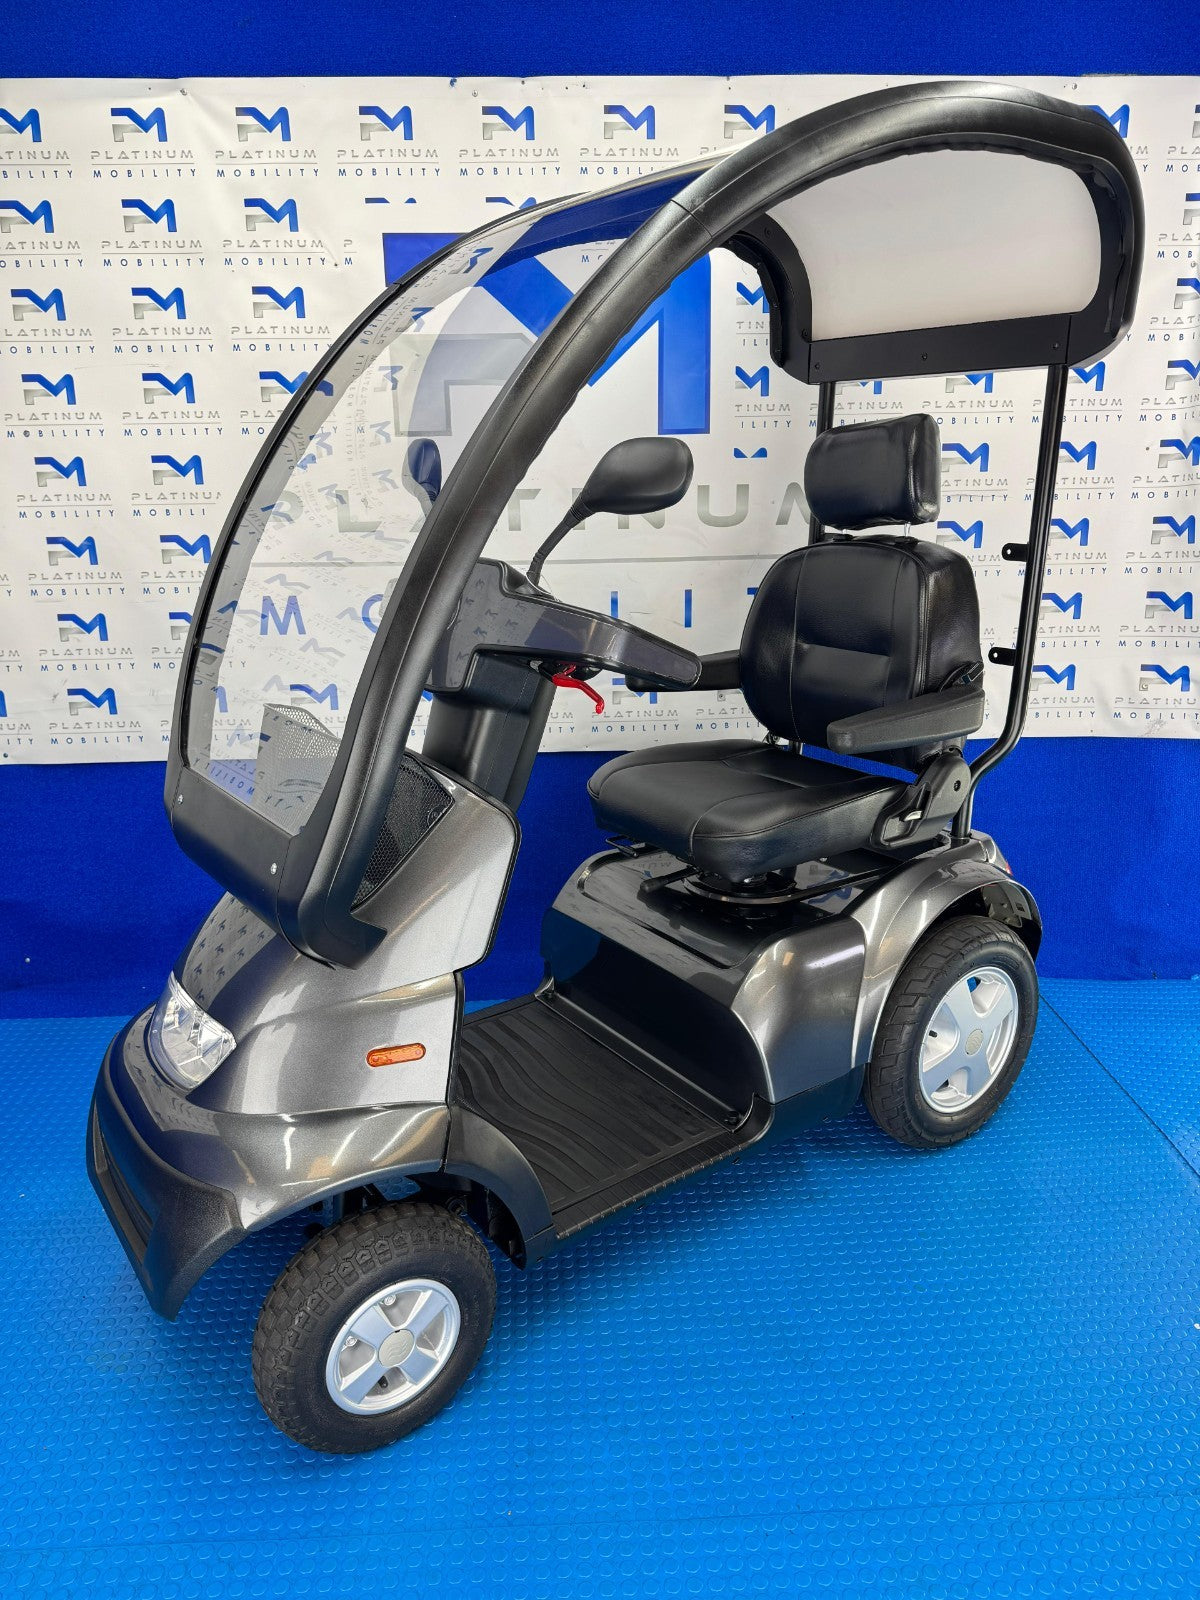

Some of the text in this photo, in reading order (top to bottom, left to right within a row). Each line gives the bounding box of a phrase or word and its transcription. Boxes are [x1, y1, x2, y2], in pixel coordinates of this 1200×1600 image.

[91, 150, 193, 159] PLATINUM
[215, 150, 316, 159] PLATINUM
[337, 149, 438, 158] PLATINUM
[459, 149, 558, 157] PLATINUM
[580, 148, 678, 156] PLATINUM
[3, 170, 72, 178] BILITY
[94, 169, 195, 177] MOBILITY
[217, 169, 318, 177] MOBILITY
[339, 168, 439, 176] MOBILITY
[460, 167, 560, 175] MOBILITY
[0, 241, 80, 249] ATINUM
[102, 240, 202, 248] PLATINUM
[223, 240, 324, 248] PLATINUM
[113, 327, 211, 335] PLATINUM
[231, 326, 329, 334] PLATINUM
[115, 345, 213, 353] MOBILITY
[809, 402, 903, 410] PATINUM
[922, 400, 1013, 408] PLATINUM
[4, 412, 101, 421] PLATINUM
[122, 411, 220, 419] PLATINUM
[124, 428, 222, 436] MOBILITY
[17, 494, 111, 502] PLATINUM
[19, 510, 113, 518] MOBILITY
[28, 572, 122, 580] PLATINUM
[1017, 568, 1106, 576] MBILITY
[31, 588, 124, 596] MOBILITY
[39, 648, 132, 656] PLATINUM
[41, 661, 134, 671] MOBILITY
[49, 721, 140, 729] PLATINUM
[592, 724, 679, 732] MOBILITY
[51, 736, 143, 744] MOBILITY
